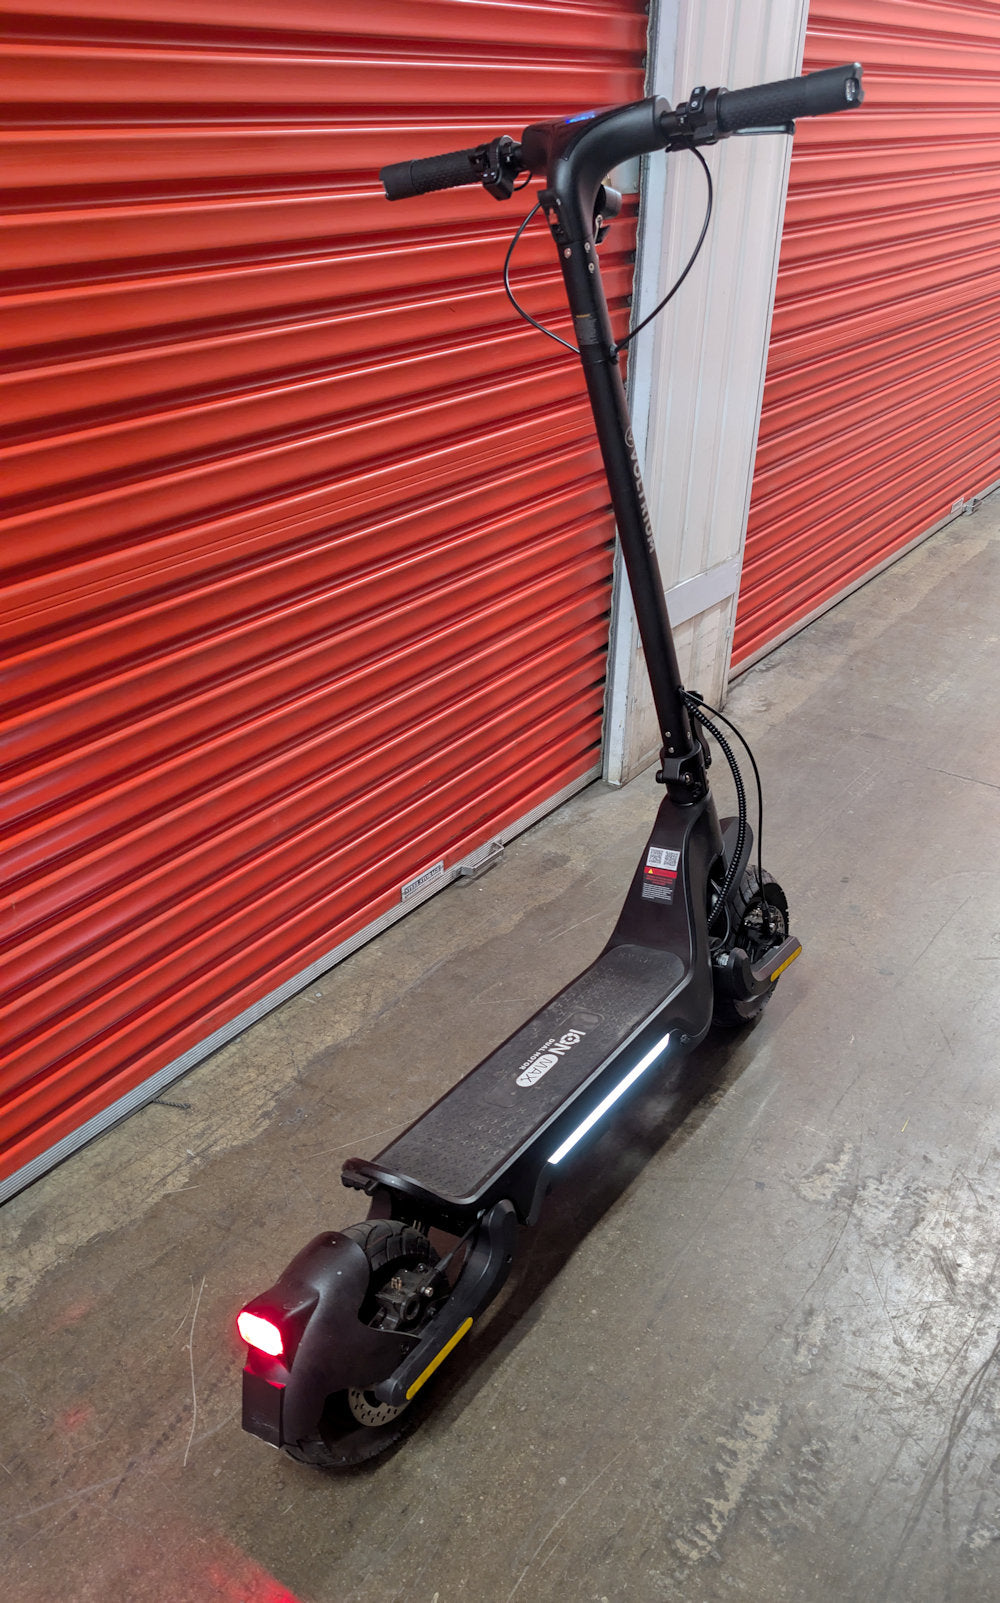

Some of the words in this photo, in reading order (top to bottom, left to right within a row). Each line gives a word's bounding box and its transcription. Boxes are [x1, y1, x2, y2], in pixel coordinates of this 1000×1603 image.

[538, 1038, 556, 1052] DUAL
[548, 1029, 586, 1055] ION
[518, 1051, 542, 1071] MOTOR
[520, 1057, 553, 1083] MAX
